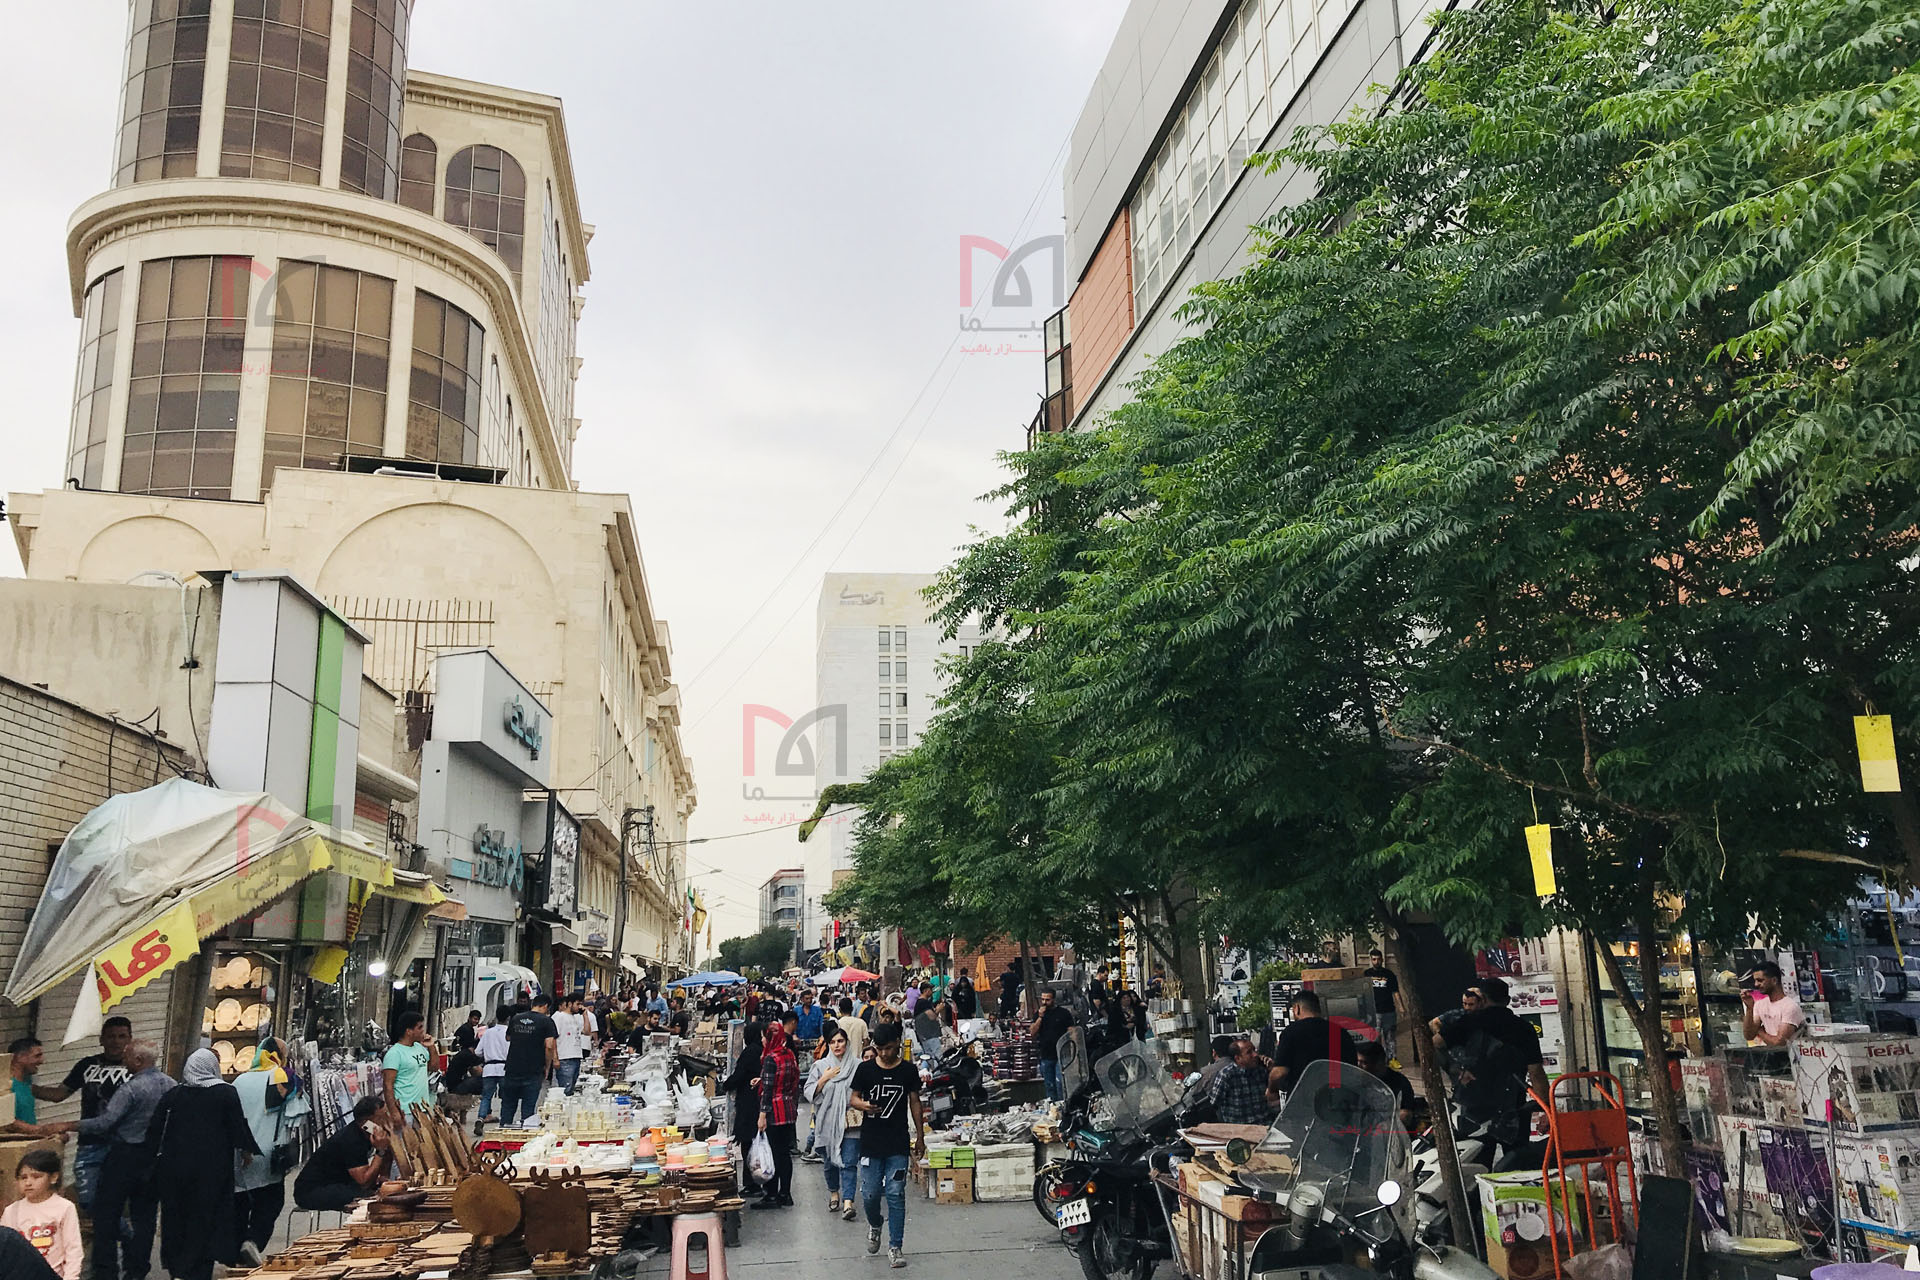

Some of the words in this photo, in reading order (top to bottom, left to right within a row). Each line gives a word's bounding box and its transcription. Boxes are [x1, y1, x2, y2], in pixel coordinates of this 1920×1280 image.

[1798, 1043, 1828, 1059] Tefal
[1864, 1043, 1914, 1058] Tefal
[412, 1053, 427, 1065] Y-3
[867, 1084, 904, 1119] 17
